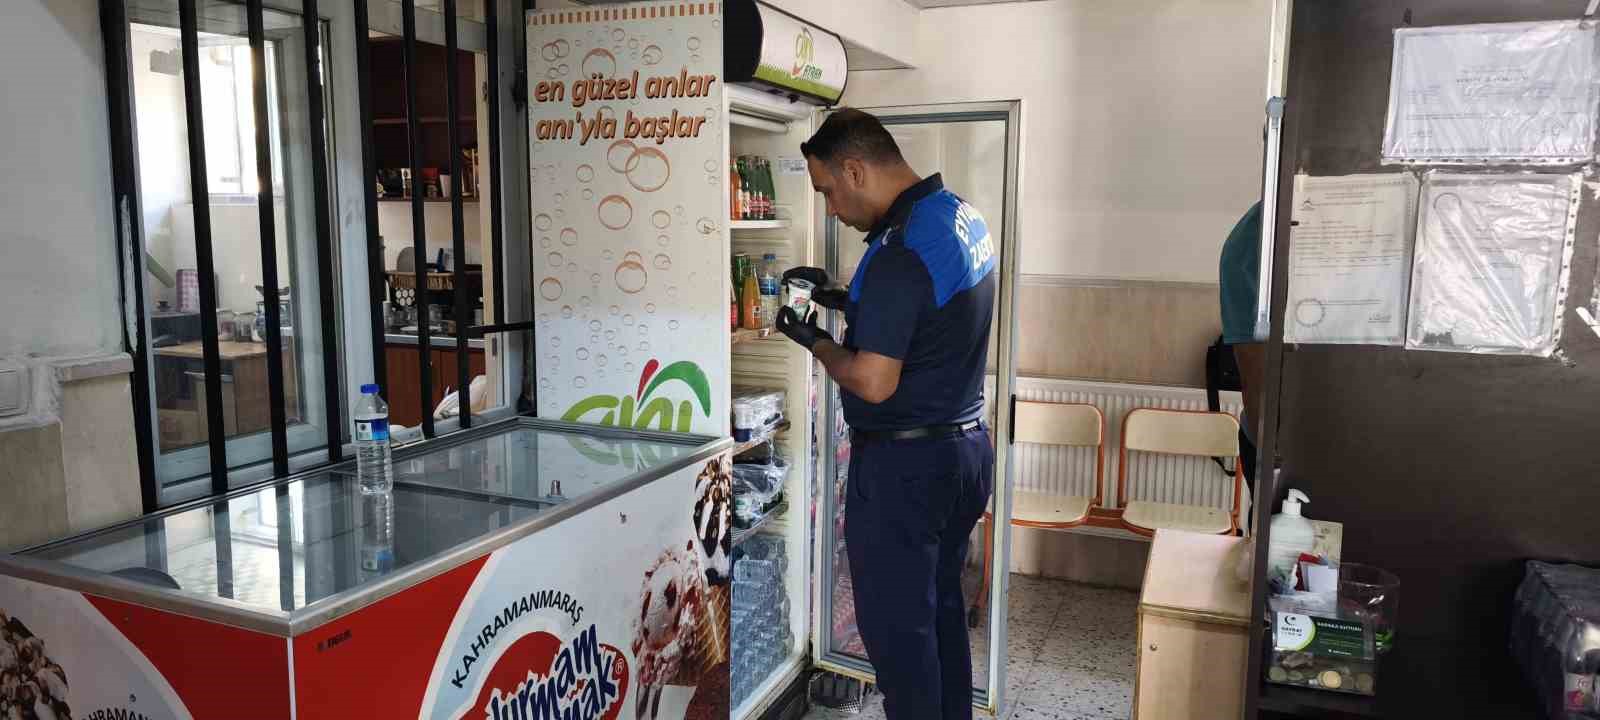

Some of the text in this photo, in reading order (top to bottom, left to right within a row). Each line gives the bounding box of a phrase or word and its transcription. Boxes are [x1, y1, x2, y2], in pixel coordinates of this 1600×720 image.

[534, 68, 716, 107] en güzel anlar
[536, 109, 706, 145] anı'yla başlar
[451, 589, 584, 689] KAHRAMANMARAŞ
